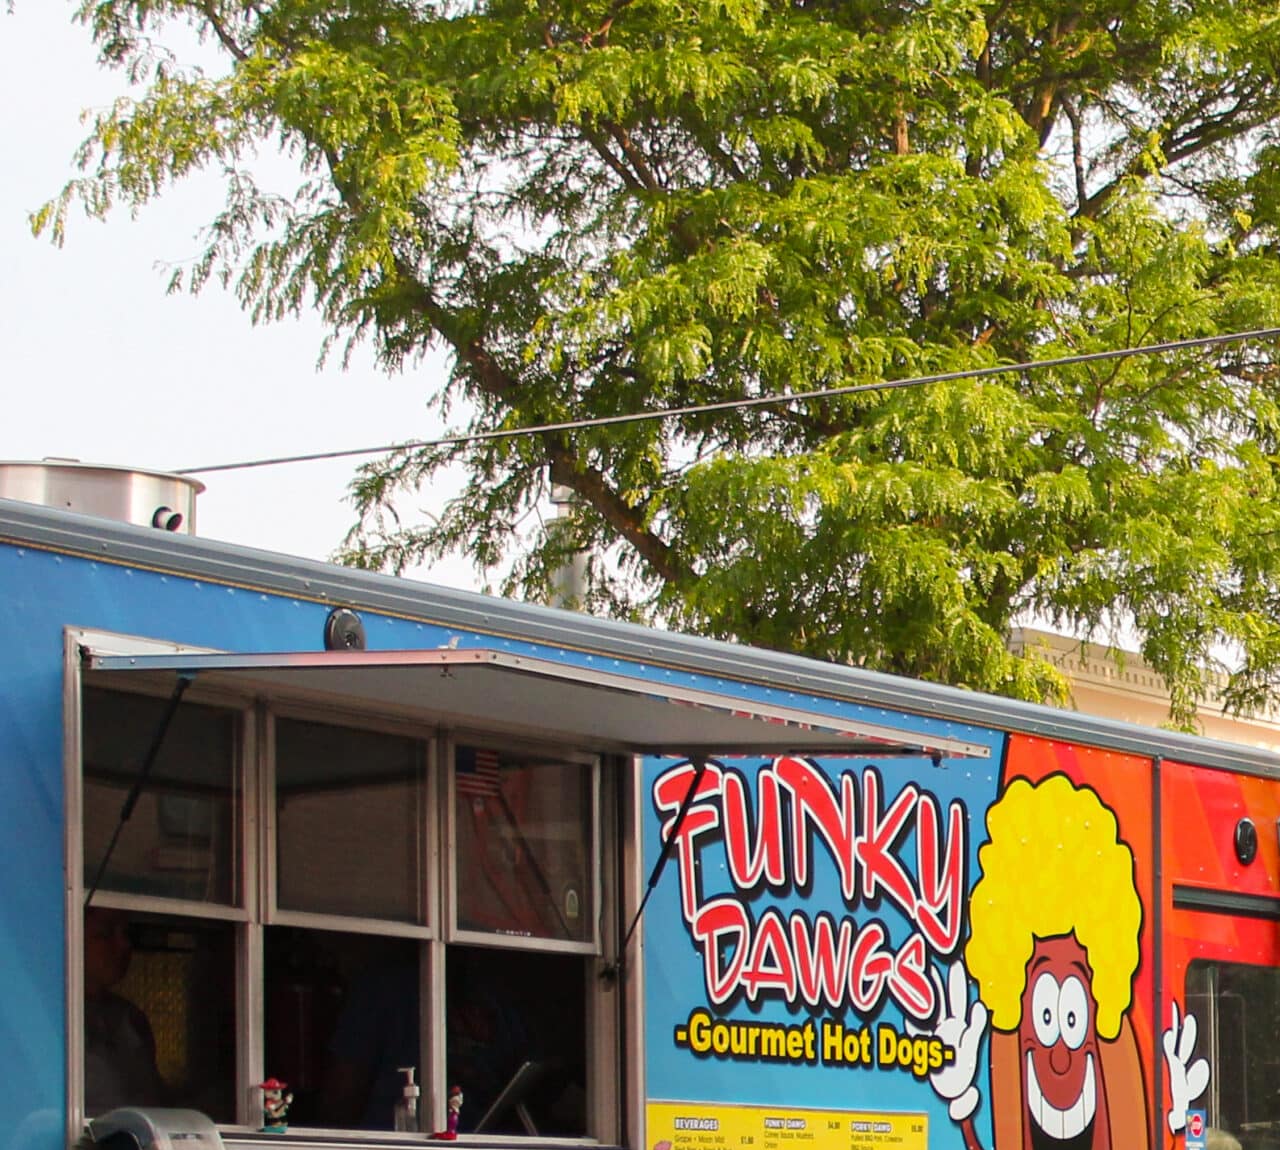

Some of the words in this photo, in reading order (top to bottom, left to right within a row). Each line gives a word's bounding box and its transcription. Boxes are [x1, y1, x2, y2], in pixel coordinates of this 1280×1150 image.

[653, 756, 965, 954] FUNKY
[692, 899, 936, 1022] DAWGS
[822, 1024, 873, 1063] Hot
[675, 1117, 719, 1131] BEVERAGES
